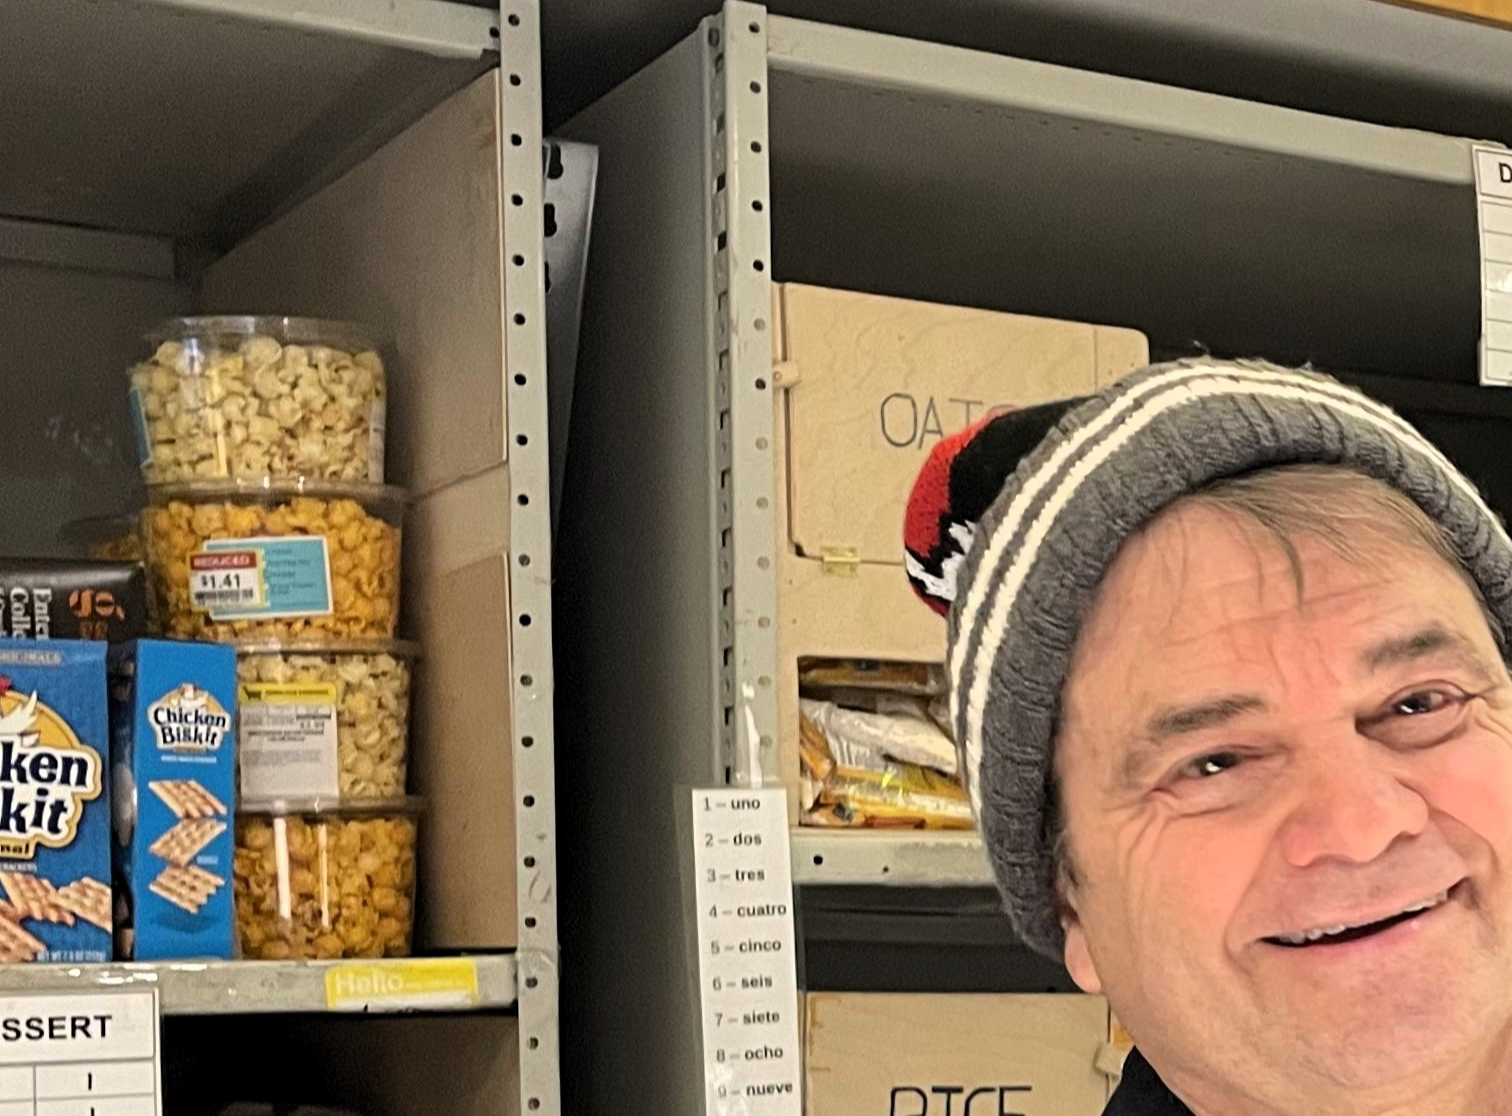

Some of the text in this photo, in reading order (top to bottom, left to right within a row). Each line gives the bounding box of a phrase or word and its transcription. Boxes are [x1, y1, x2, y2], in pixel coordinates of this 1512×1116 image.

[880, 392, 1017, 450] OAT
[193, 554, 251, 569] REDUCED
[201, 573, 241, 590] $1.41
[153, 706, 227, 728] Chicken
[161, 724, 218, 746] Biskit
[0, 740, 89, 788] ken
[0, 787, 68, 834] kit
[704, 797, 711, 811] 1
[730, 797, 761, 810] uno
[705, 833, 714, 847] 2
[733, 831, 762, 846] dos
[707, 868, 716, 882] 3
[735, 868, 765, 881] tres
[708, 904, 717, 918] 4
[737, 903, 787, 918] cuatro
[739, 938, 782, 953] cinco
[712, 976, 722, 991] 6
[741, 974, 773, 989] seis
[715, 1012, 724, 1027] 7
[743, 1010, 780, 1025] siete
[2, 1014, 112, 1041] SSERT
[716, 1049, 725, 1063] 8
[744, 1045, 784, 1061] ocho
[718, 1085, 727, 1099] 9
[746, 1082, 793, 1097] nueve
